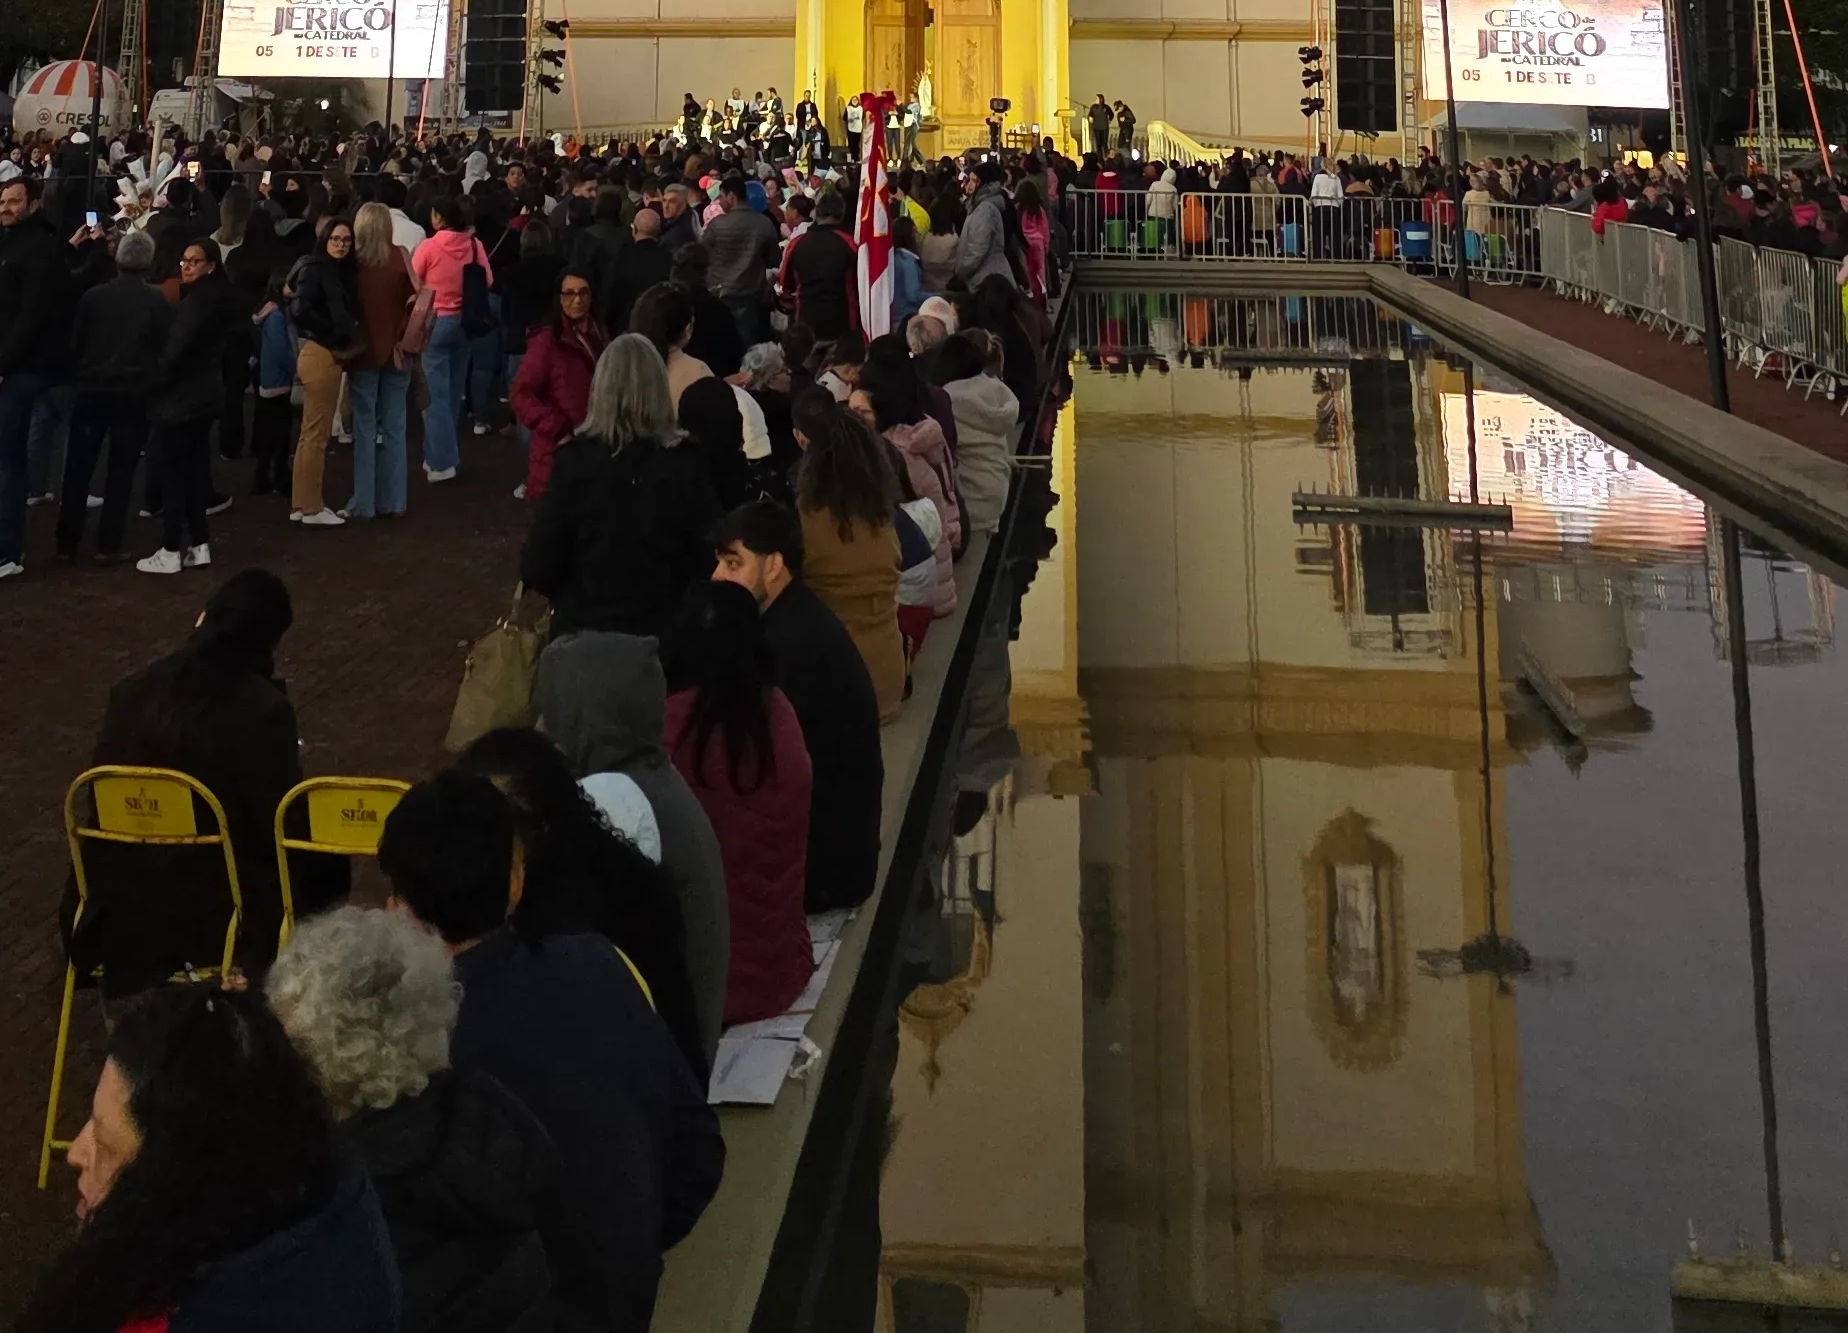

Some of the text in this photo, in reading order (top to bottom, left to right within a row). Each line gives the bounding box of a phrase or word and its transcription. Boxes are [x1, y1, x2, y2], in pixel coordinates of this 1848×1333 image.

[271, 2, 392, 37] JERICÓ
[1485, 9, 1581, 29] CERCO
[304, 31, 371, 40] CATEDRAL
[1476, 26, 1607, 59] JERICÓ
[256, 45, 274, 57] 05
[306, 46, 323, 58] DE
[1512, 55, 1586, 66] CATEDRAL
[1462, 69, 1481, 81] 05
[1516, 71, 1535, 83] DE
